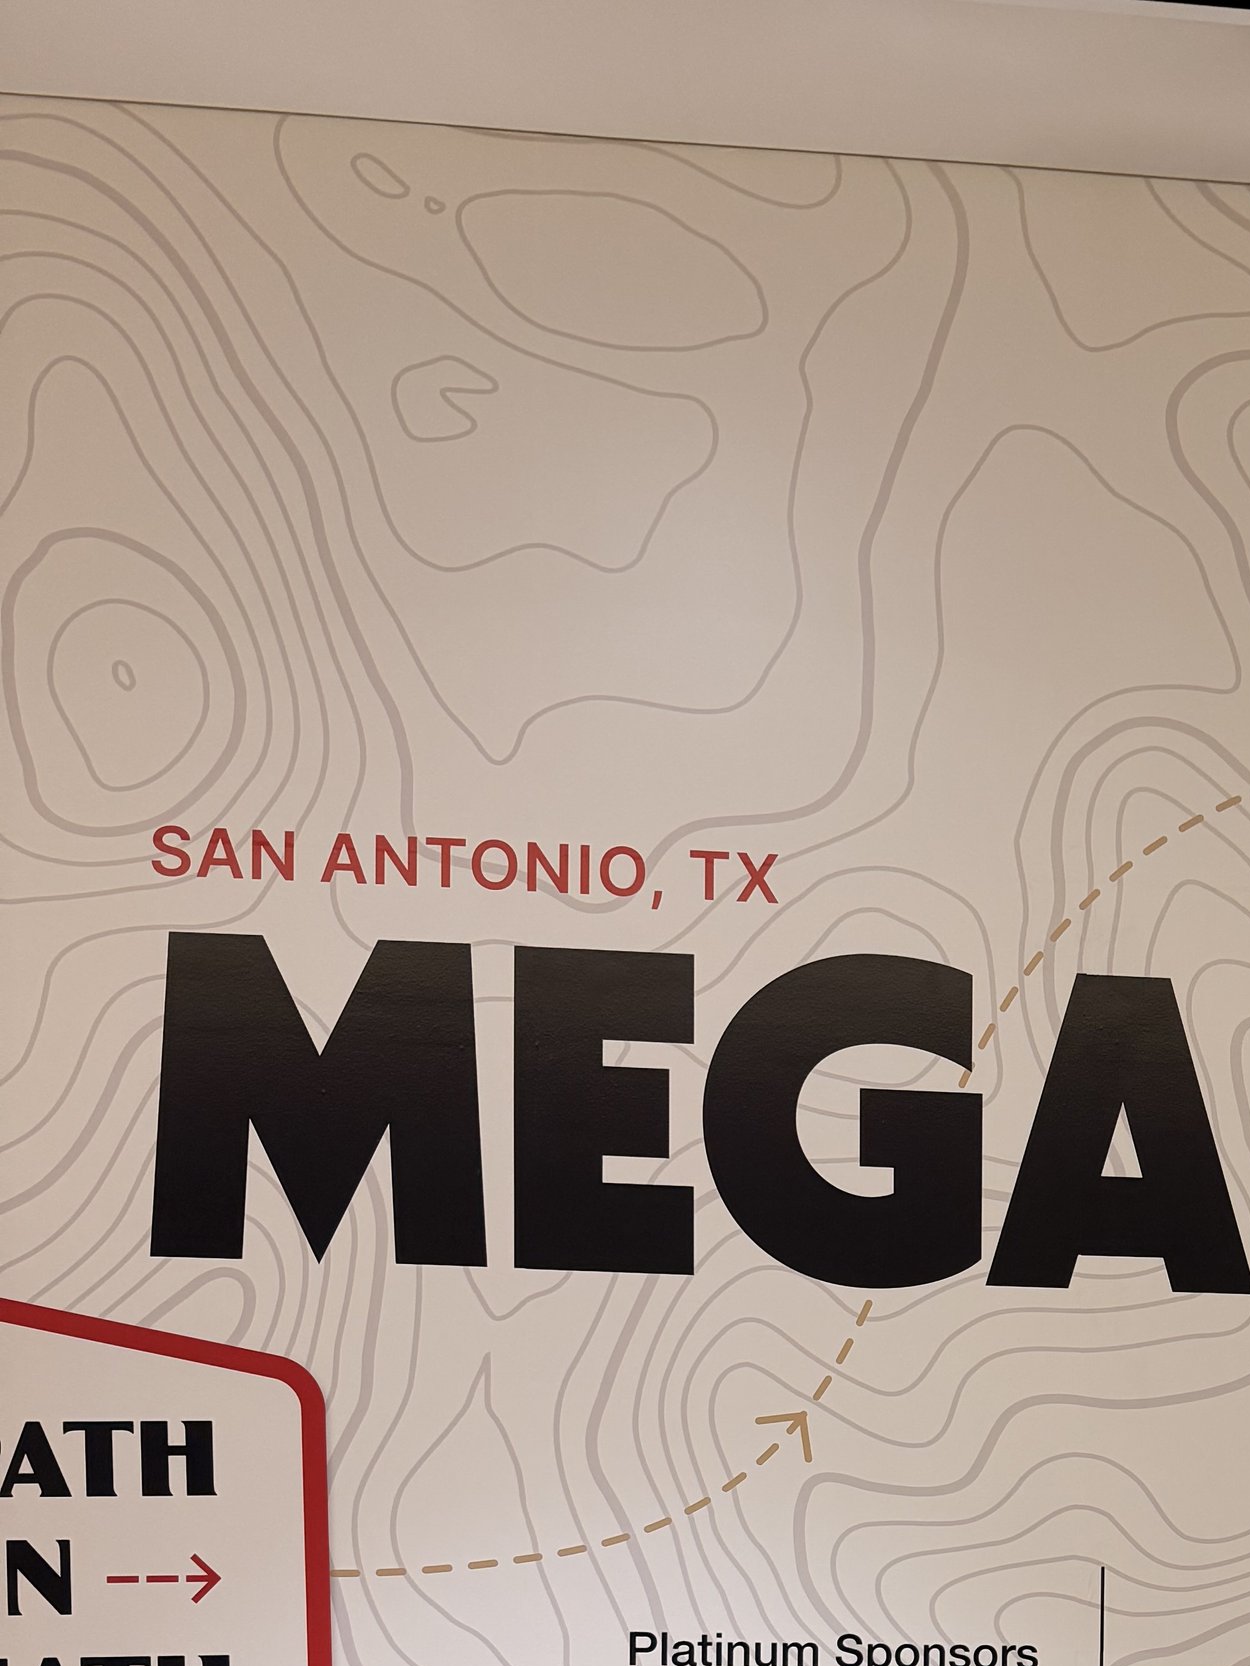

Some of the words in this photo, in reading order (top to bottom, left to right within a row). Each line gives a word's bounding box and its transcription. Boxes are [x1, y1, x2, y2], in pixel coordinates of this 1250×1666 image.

[151, 825, 295, 881] SAN
[321, 833, 663, 910] ANTONIO,
[689, 849, 779, 904] TX
[0, 1420, 217, 1498] ATH
